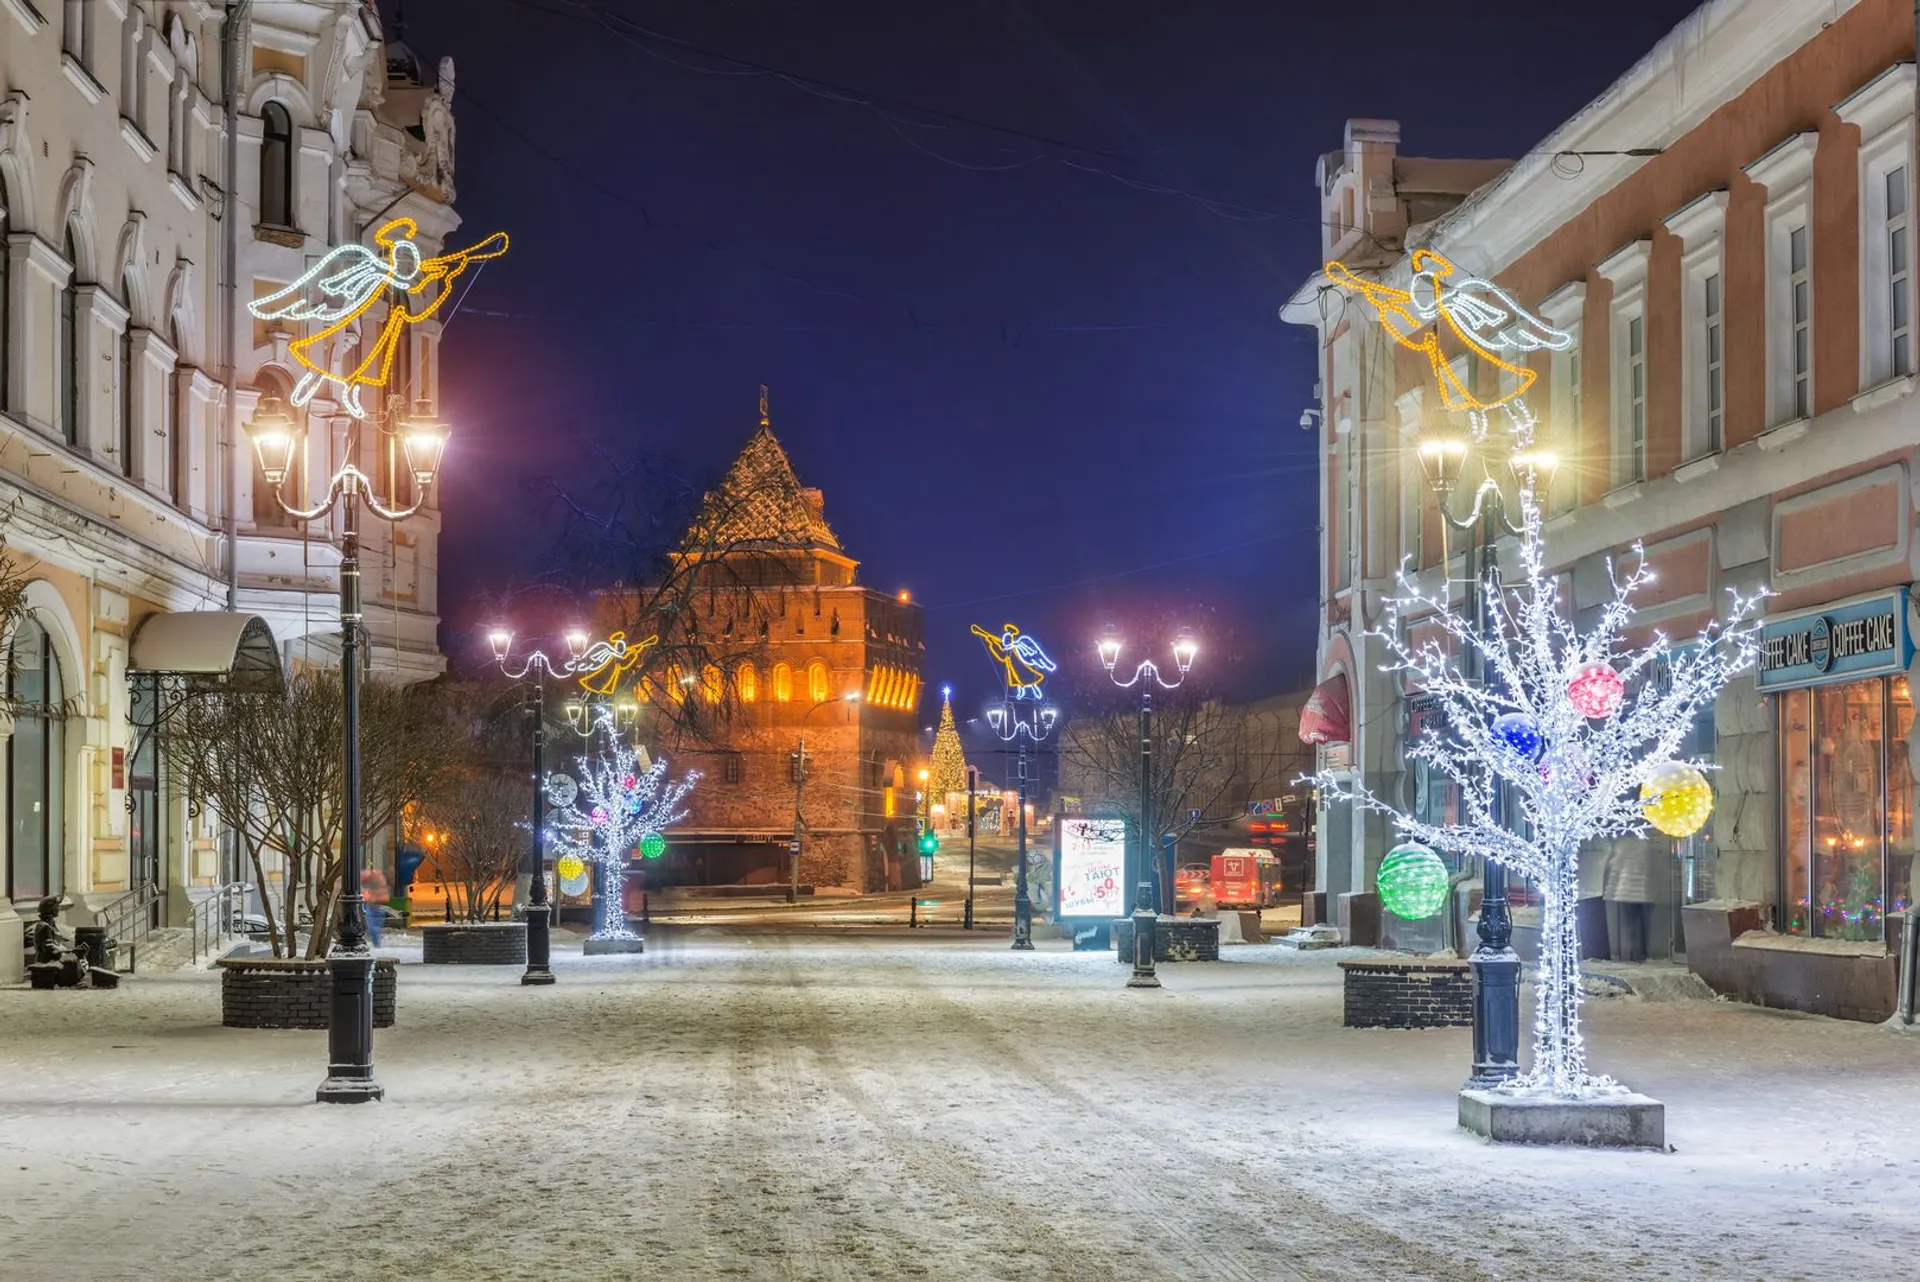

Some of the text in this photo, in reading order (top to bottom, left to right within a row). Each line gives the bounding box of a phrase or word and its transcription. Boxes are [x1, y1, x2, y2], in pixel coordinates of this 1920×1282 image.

[1757, 632, 1808, 670] COFFEE CAKE
[1833, 615, 1892, 657] COFFEE CAKE
[1085, 867, 1120, 882] ТАЮТ
